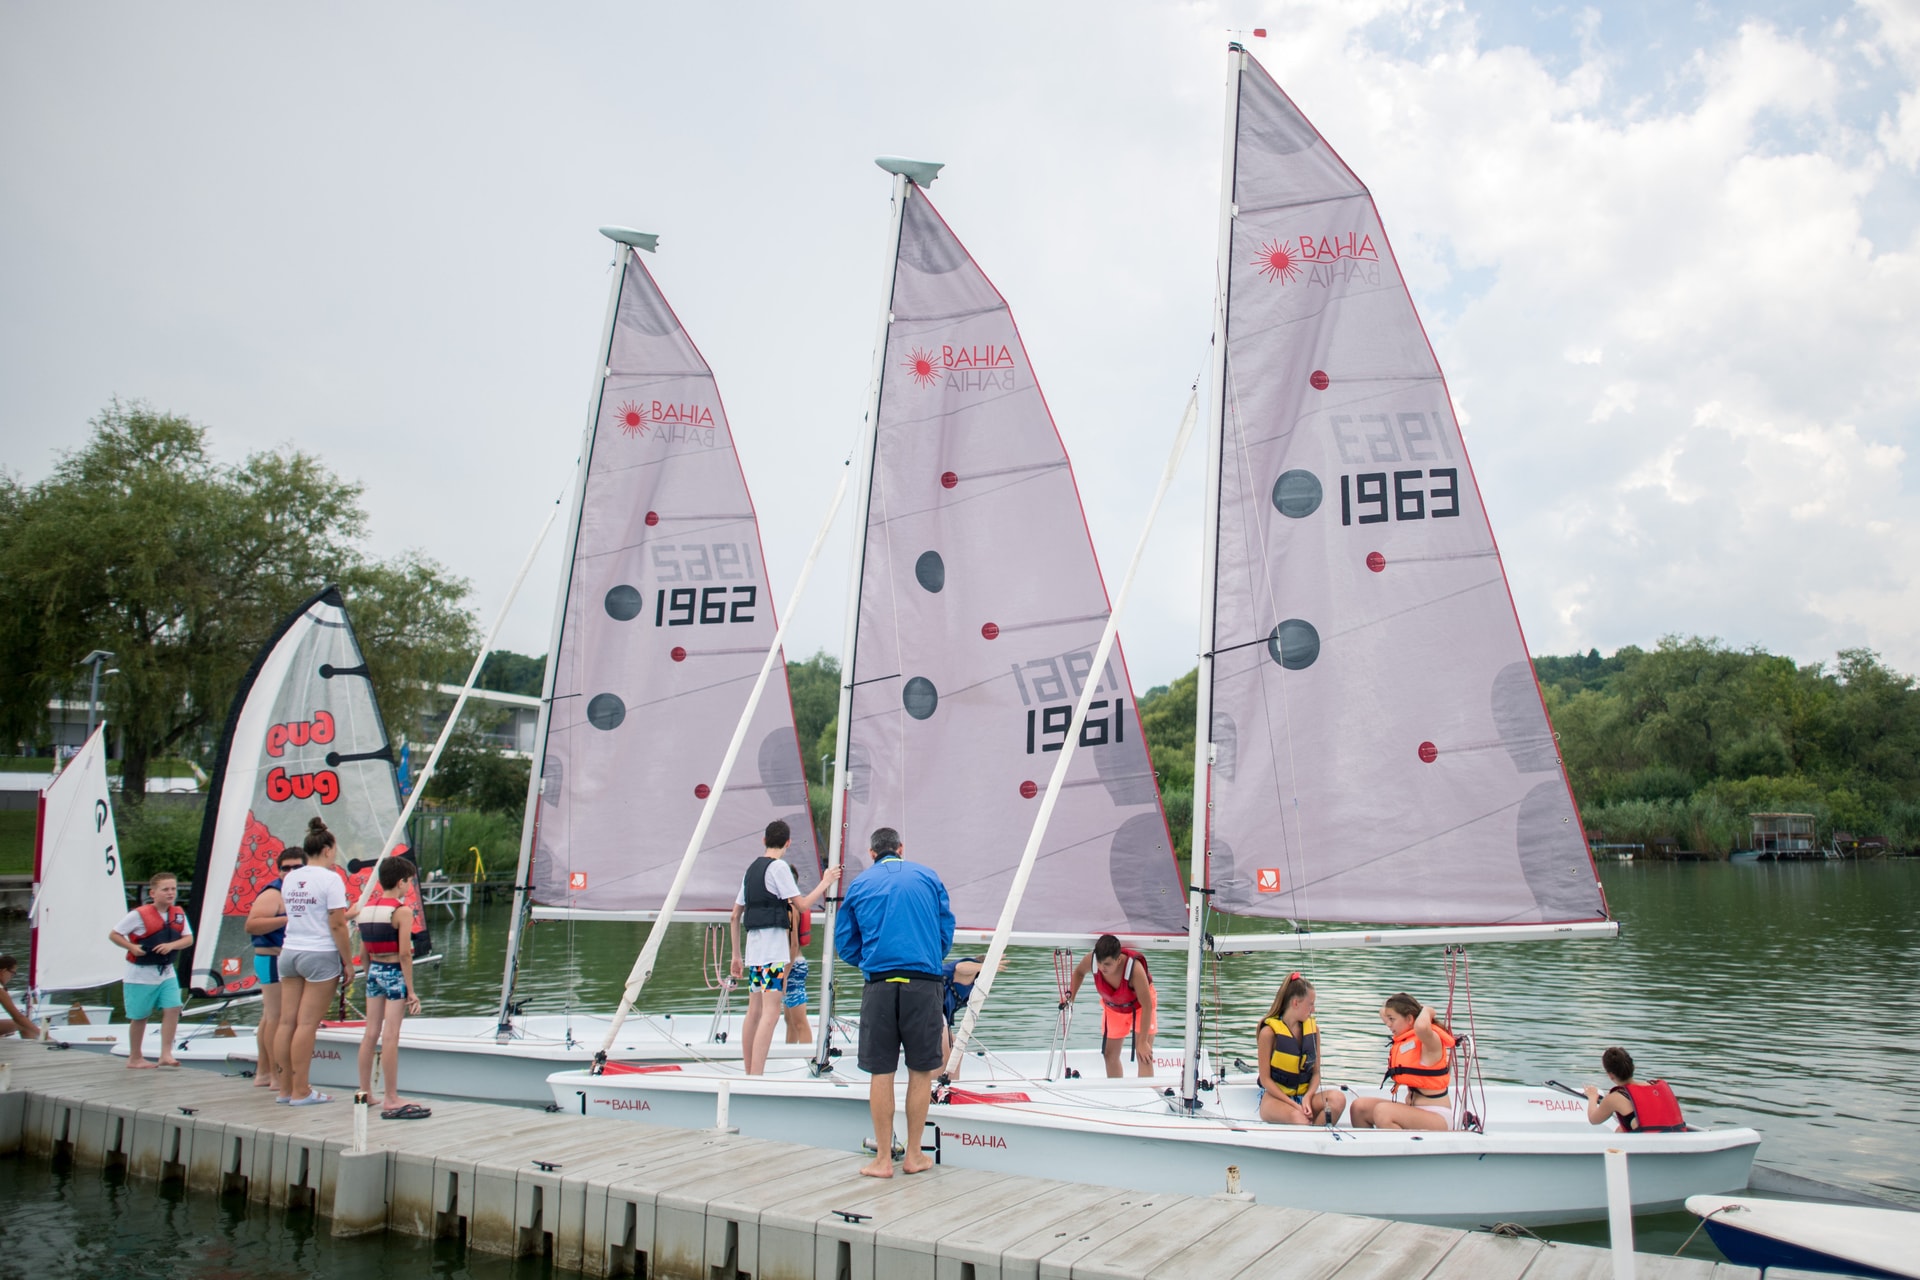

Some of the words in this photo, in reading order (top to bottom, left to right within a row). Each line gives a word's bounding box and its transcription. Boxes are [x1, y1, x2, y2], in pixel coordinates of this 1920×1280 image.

[1299, 231, 1379, 259] BAHIA
[942, 344, 1014, 368] BAHIA
[652, 400, 715, 426] BAHIA
[1340, 468, 1459, 526] 1963
[655, 586, 756, 627] 1962
[1026, 698, 1123, 754] 1961
[106, 844, 116, 876] 5
[576, 1091, 586, 1115] 1
[612, 1099, 651, 1111] BAHIA
[1545, 1099, 1584, 1111] BAHIA
[962, 1133, 1007, 1149] BAHIA
